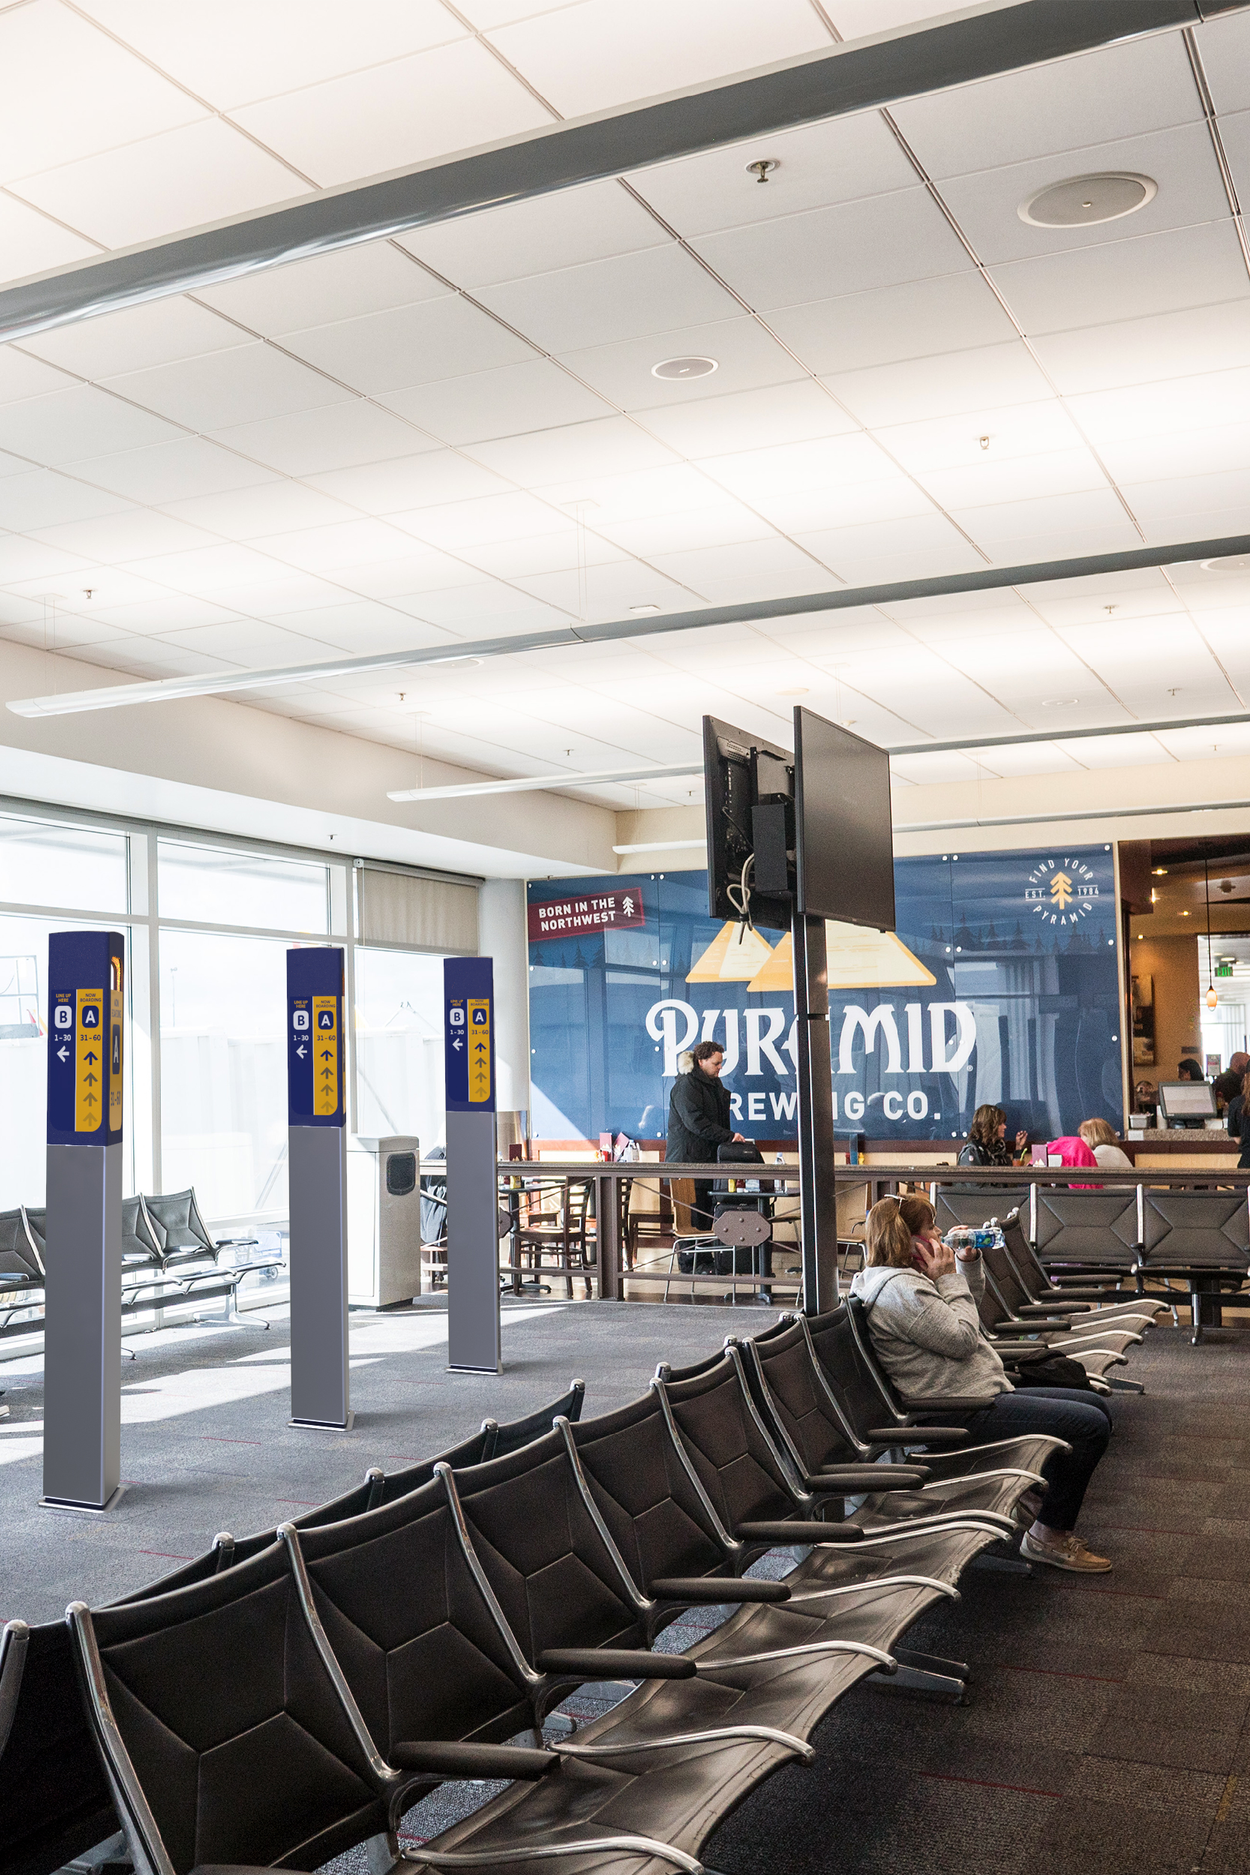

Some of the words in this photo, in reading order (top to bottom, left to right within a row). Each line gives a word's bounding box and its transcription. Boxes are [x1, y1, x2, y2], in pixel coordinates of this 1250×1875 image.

[1029, 860, 1054, 883] FIND
[1064, 858, 1093, 880] YOUR
[1025, 890, 1046, 898] EST.
[1078, 888, 1099, 896] 1984
[538, 904, 571, 918] BORN
[575, 902, 588, 912] IN
[591, 897, 616, 910] THE
[1033, 902, 1092, 925] PYRAMID
[540, 911, 616, 932] NORTHWEST
[60, 1010, 68, 1023] B
[85, 1010, 96, 1023] A
[298, 1015, 305, 1026] B
[321, 1015, 331, 1026] A
[454, 1012, 461, 1021] B
[475, 1012, 484, 1022] A
[114, 1036, 119, 1063] A
[883, 1090, 940, 1120] CO.
